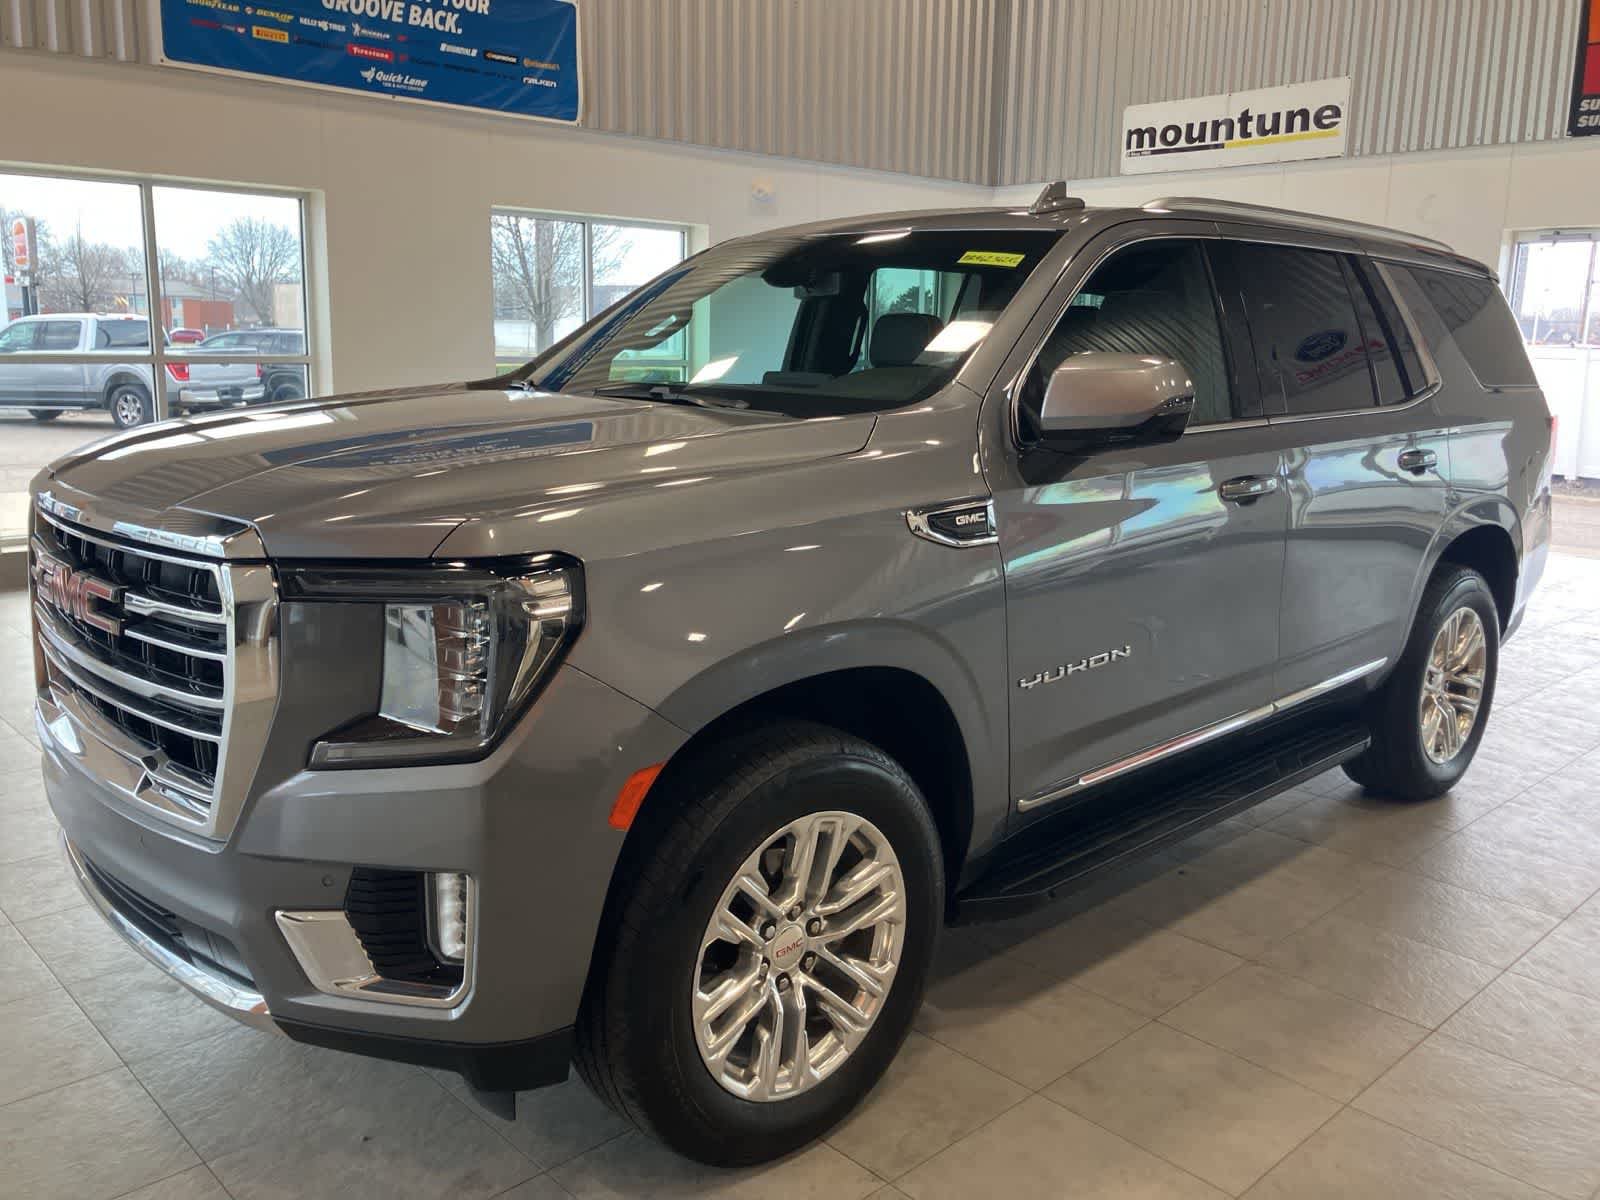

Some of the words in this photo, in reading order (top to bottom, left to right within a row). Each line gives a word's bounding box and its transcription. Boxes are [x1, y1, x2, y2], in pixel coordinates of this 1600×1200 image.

[408, 4, 463, 34] BACK.
[442, 0, 490, 15] OUR
[375, 71, 404, 83] Quick
[403, 75, 429, 87] Lane
[1126, 104, 1342, 150] mountune
[955, 512, 986, 526] GMC
[36, 552, 121, 636] GMC
[1018, 645, 1131, 689] YUKON
[775, 937, 803, 958] GMC
